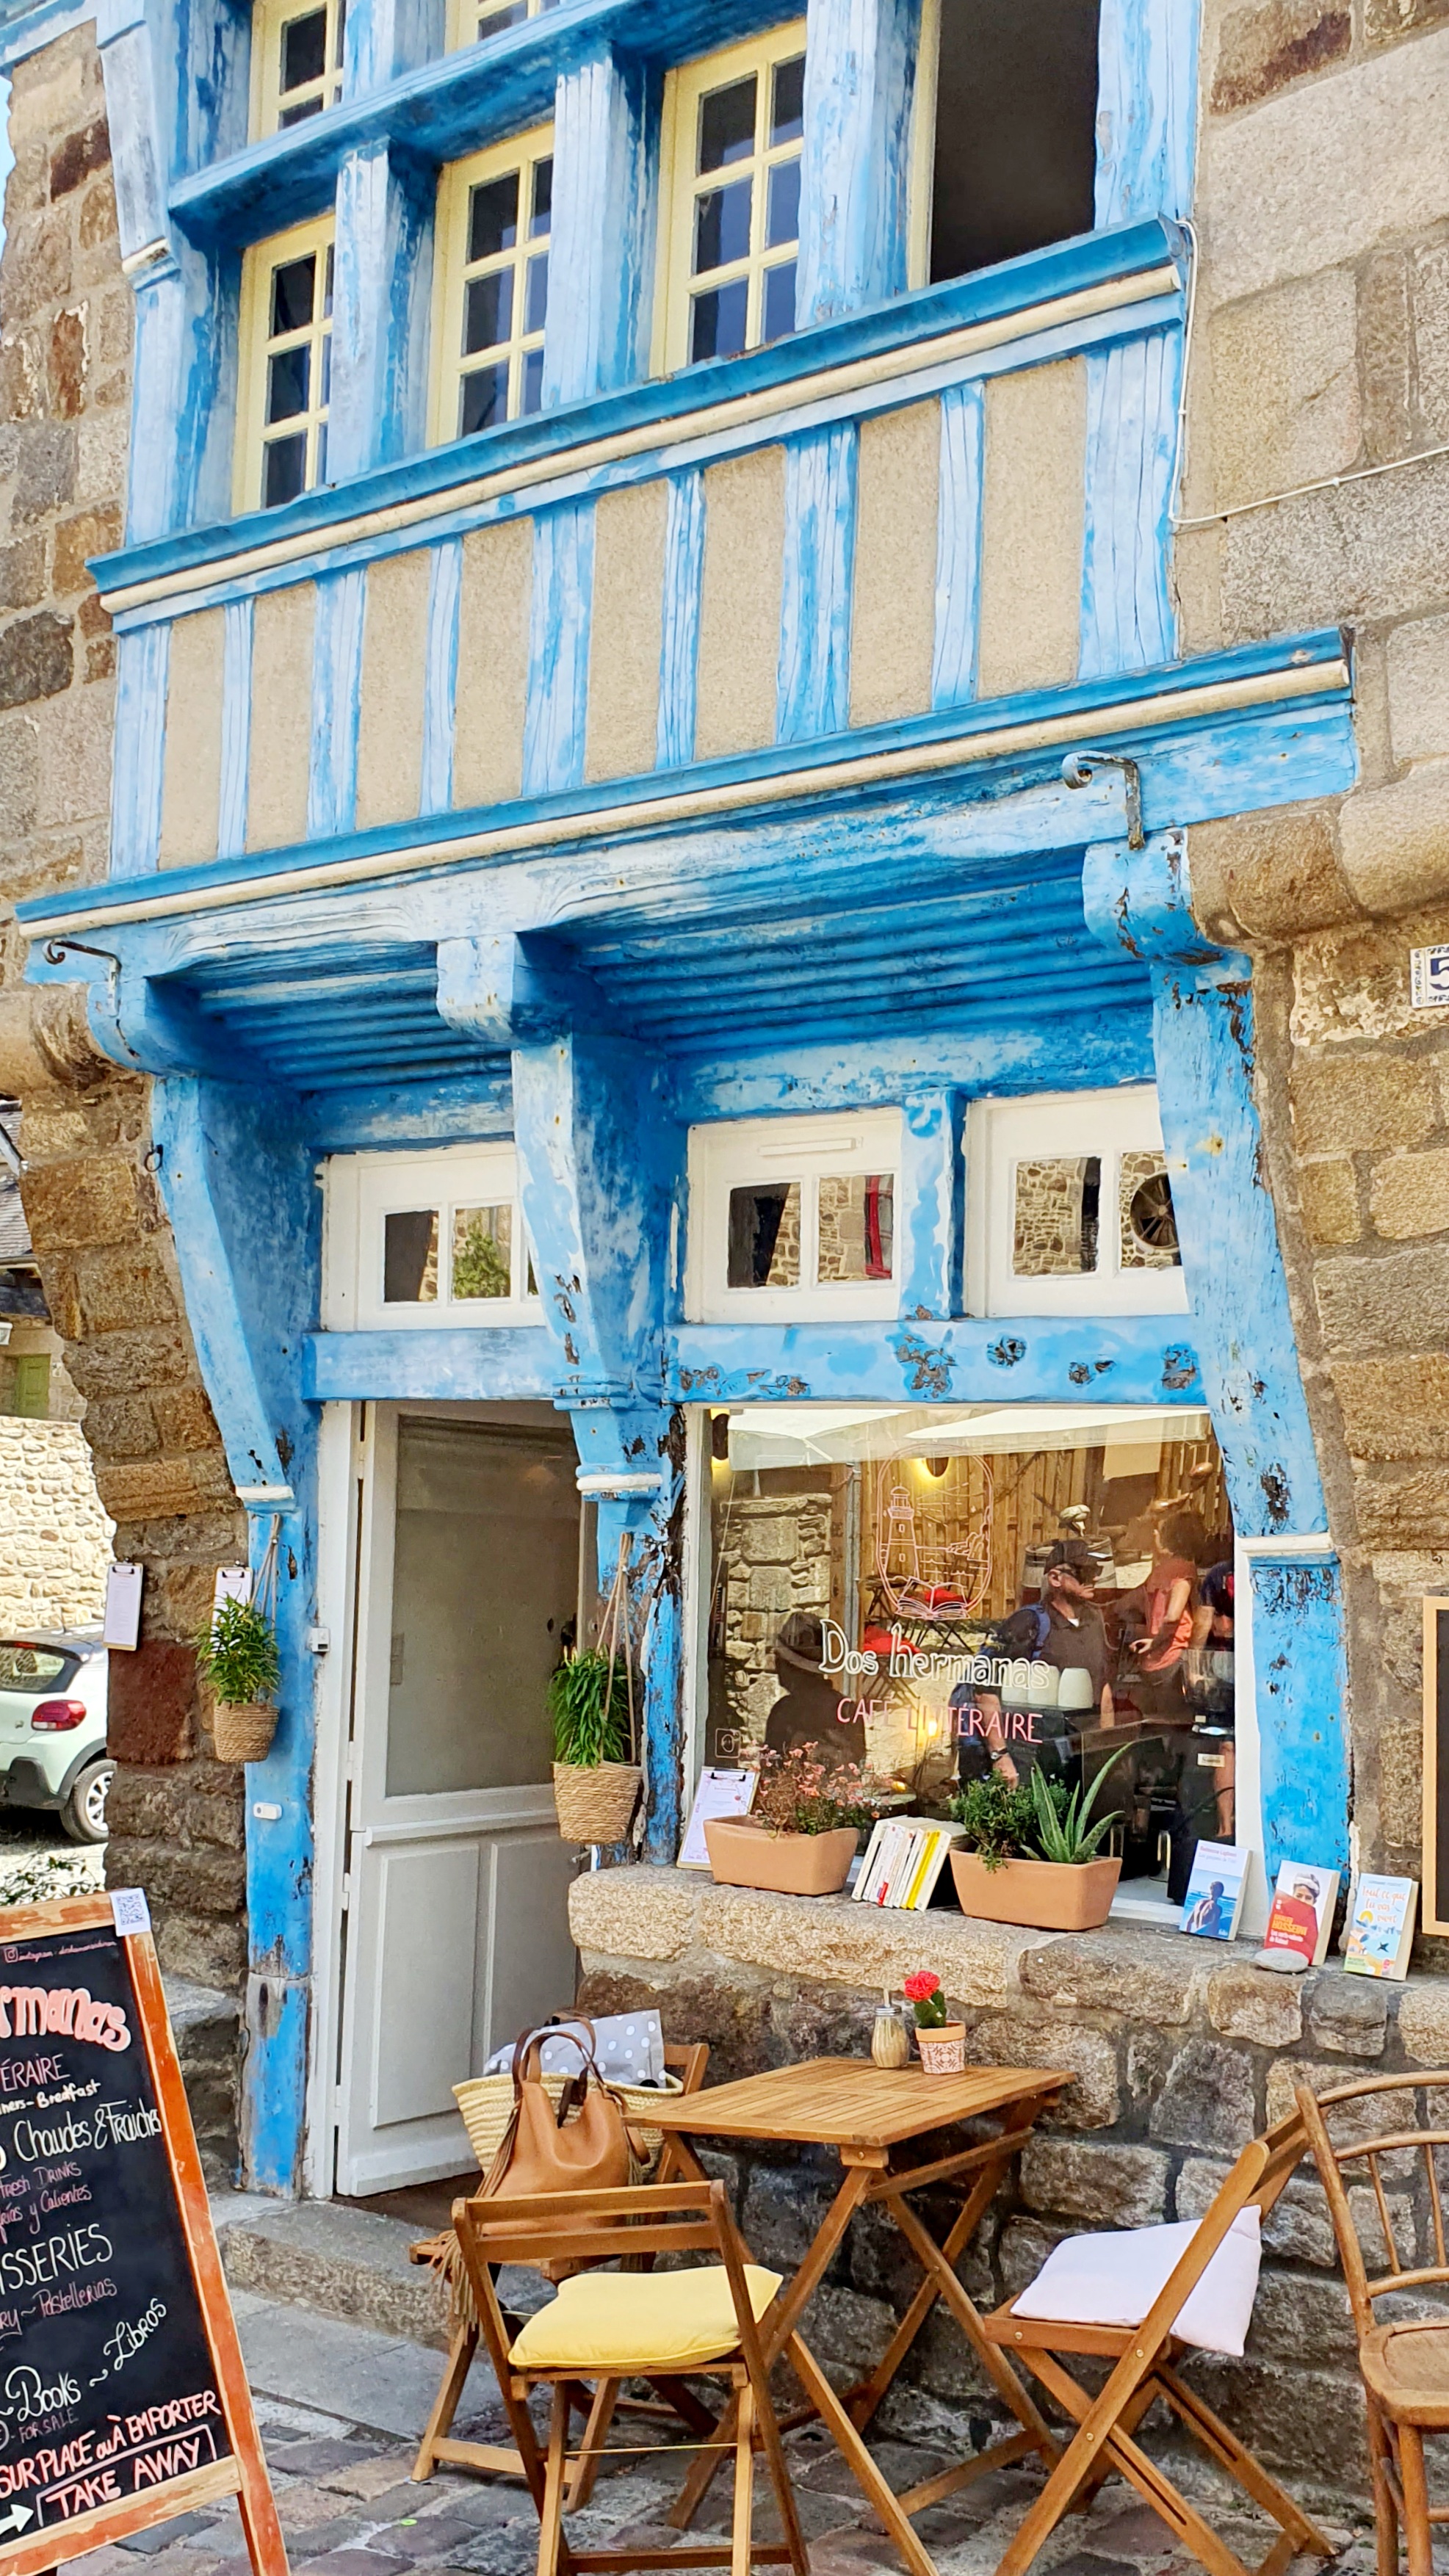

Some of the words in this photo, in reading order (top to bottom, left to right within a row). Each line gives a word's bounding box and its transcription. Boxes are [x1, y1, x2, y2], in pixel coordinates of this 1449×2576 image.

[818, 1618, 879, 1676] Dos
[889, 1621, 1050, 1690] hermanas
[836, 1692, 895, 1728] CAFÉ
[14, 2110, 93, 2162] Chaudes
[29, 2203, 40, 2235] y
[40, 2184, 93, 2213] Calientes
[5, 2365, 82, 2422] Books
[0, 2458, 41, 2498] SUR
[35, 2430, 96, 2484] PLACE
[126, 2389, 223, 2444] EMPORTER
[46, 2469, 122, 2519] TAKE
[134, 2436, 200, 2491] AWAY
